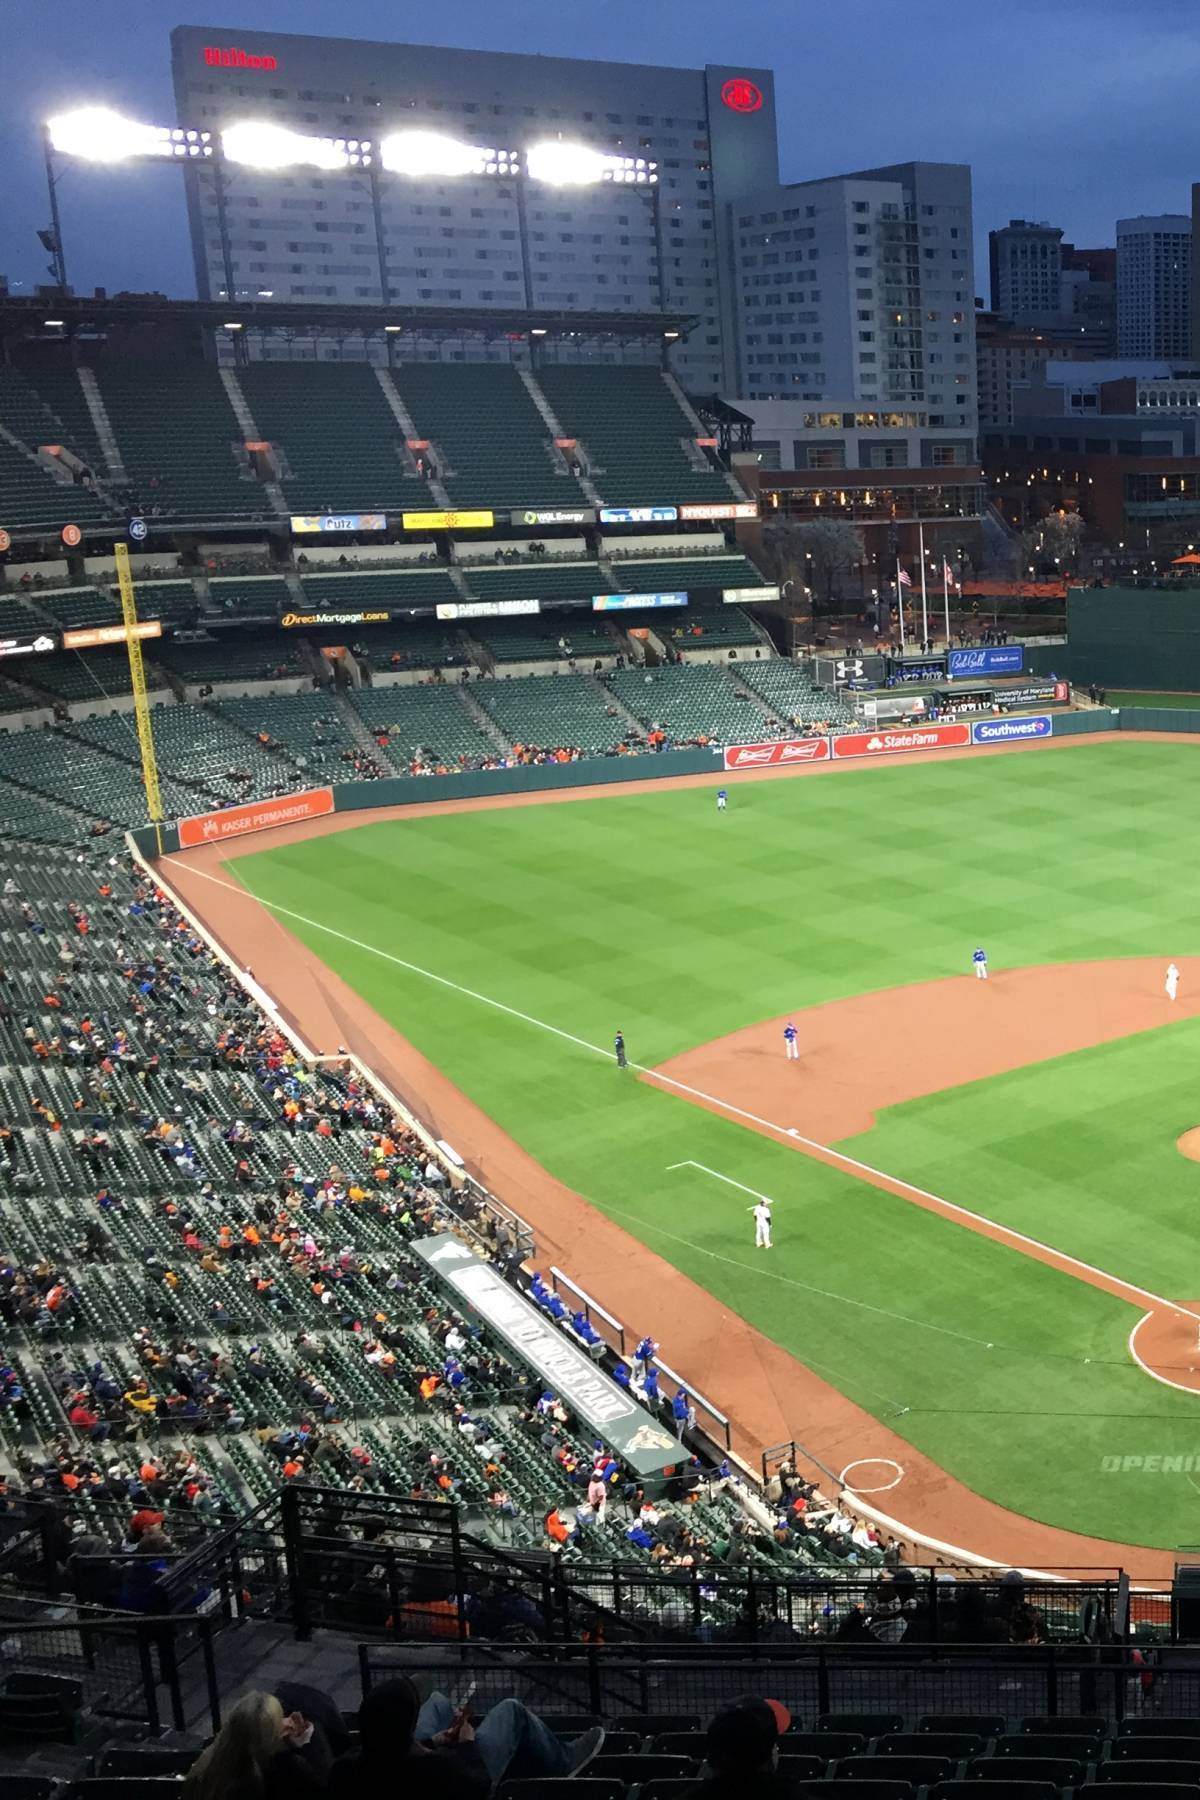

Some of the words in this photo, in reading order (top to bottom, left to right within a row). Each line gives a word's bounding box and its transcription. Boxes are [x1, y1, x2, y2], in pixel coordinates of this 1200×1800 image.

[204, 48, 277, 72] Hilton
[132, 524, 145, 536] 42
[281, 611, 389, 627] DirectMortgageLoans
[981, 723, 1037, 738] Southwest
[221, 819, 251, 833] KAISER
